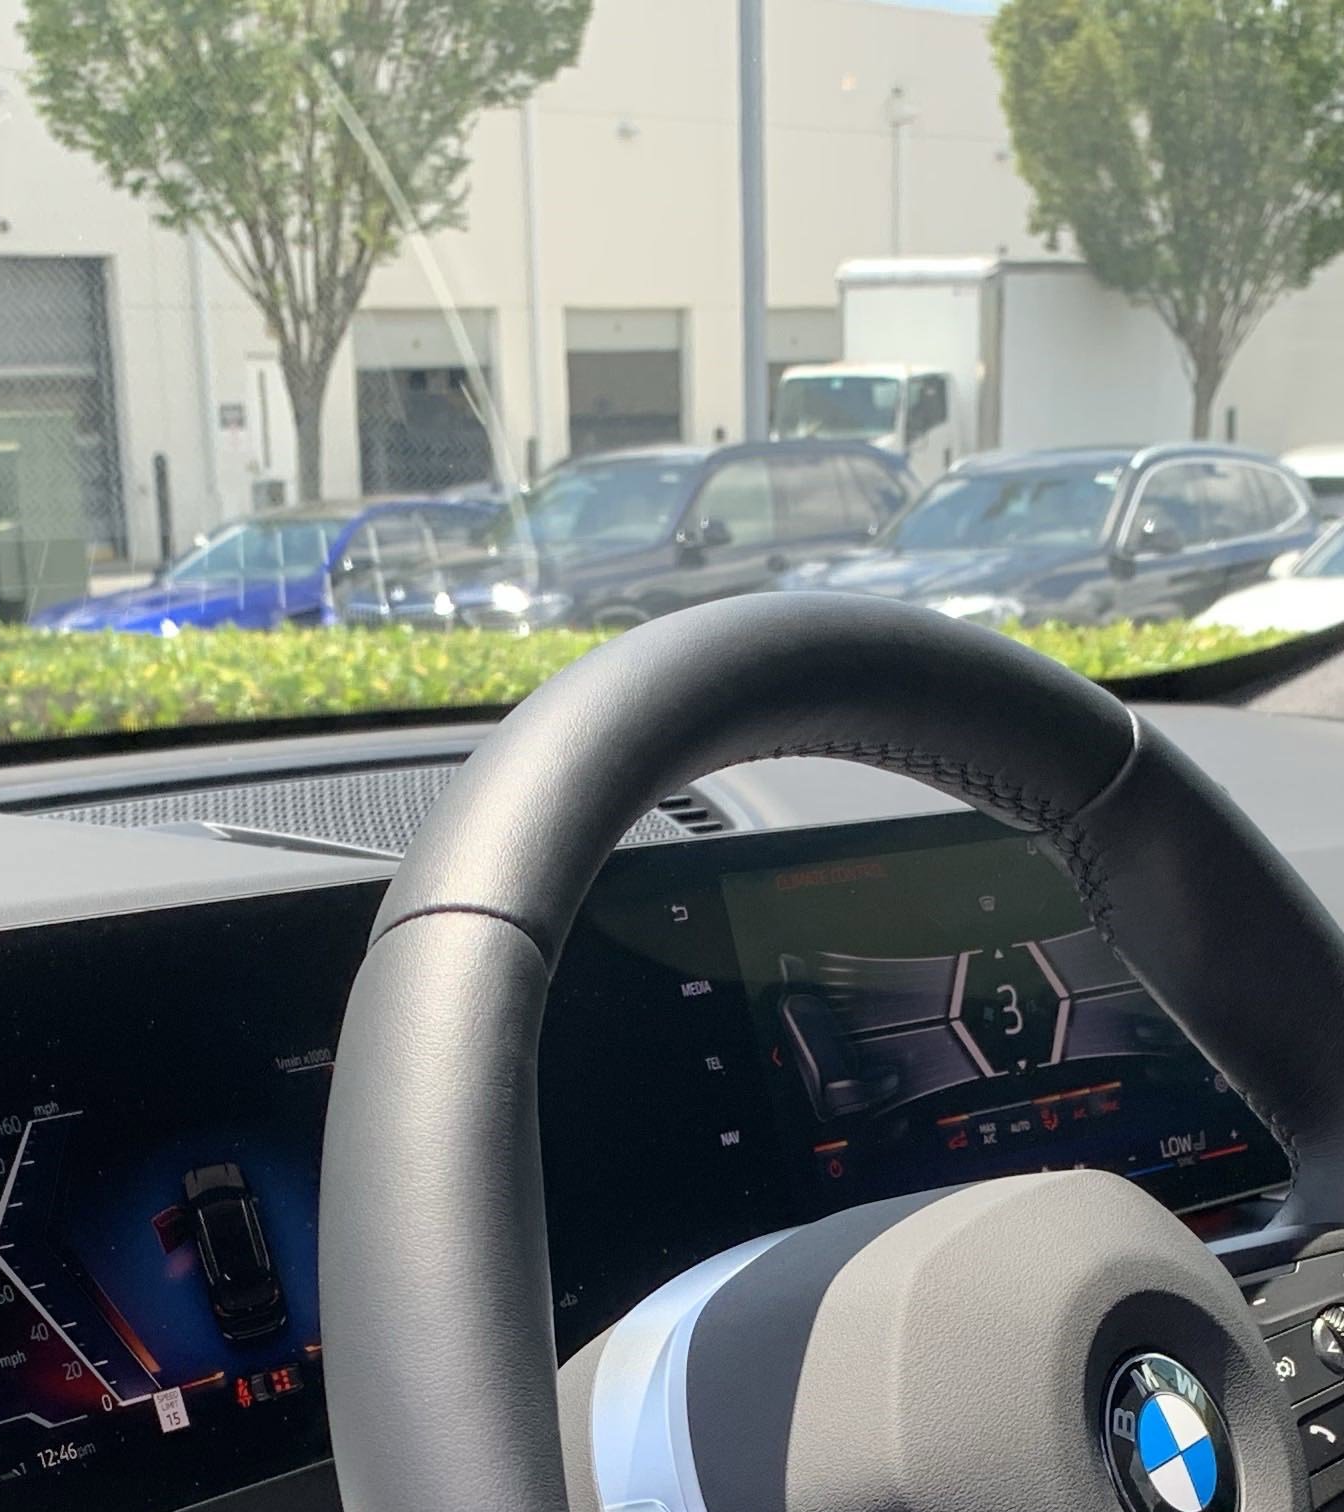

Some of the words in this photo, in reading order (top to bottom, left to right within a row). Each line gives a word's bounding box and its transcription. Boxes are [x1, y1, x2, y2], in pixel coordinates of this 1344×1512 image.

[681, 980, 712, 997] MEDIA
[995, 984, 1024, 1036] 3
[705, 1056, 724, 1071] TEL
[33, 1101, 60, 1118] mph
[1010, 1120, 1031, 1133] AUTO
[720, 1130, 740, 1147] NAV
[1159, 1133, 1192, 1158] LOW
[30, 1322, 49, 1343] 40
[0, 1350, 27, 1369] mph
[62, 1361, 83, 1381] 20
[101, 1394, 113, 1412] 0
[1113, 1361, 1199, 1442] BMW
[166, 1411, 181, 1426] 15
